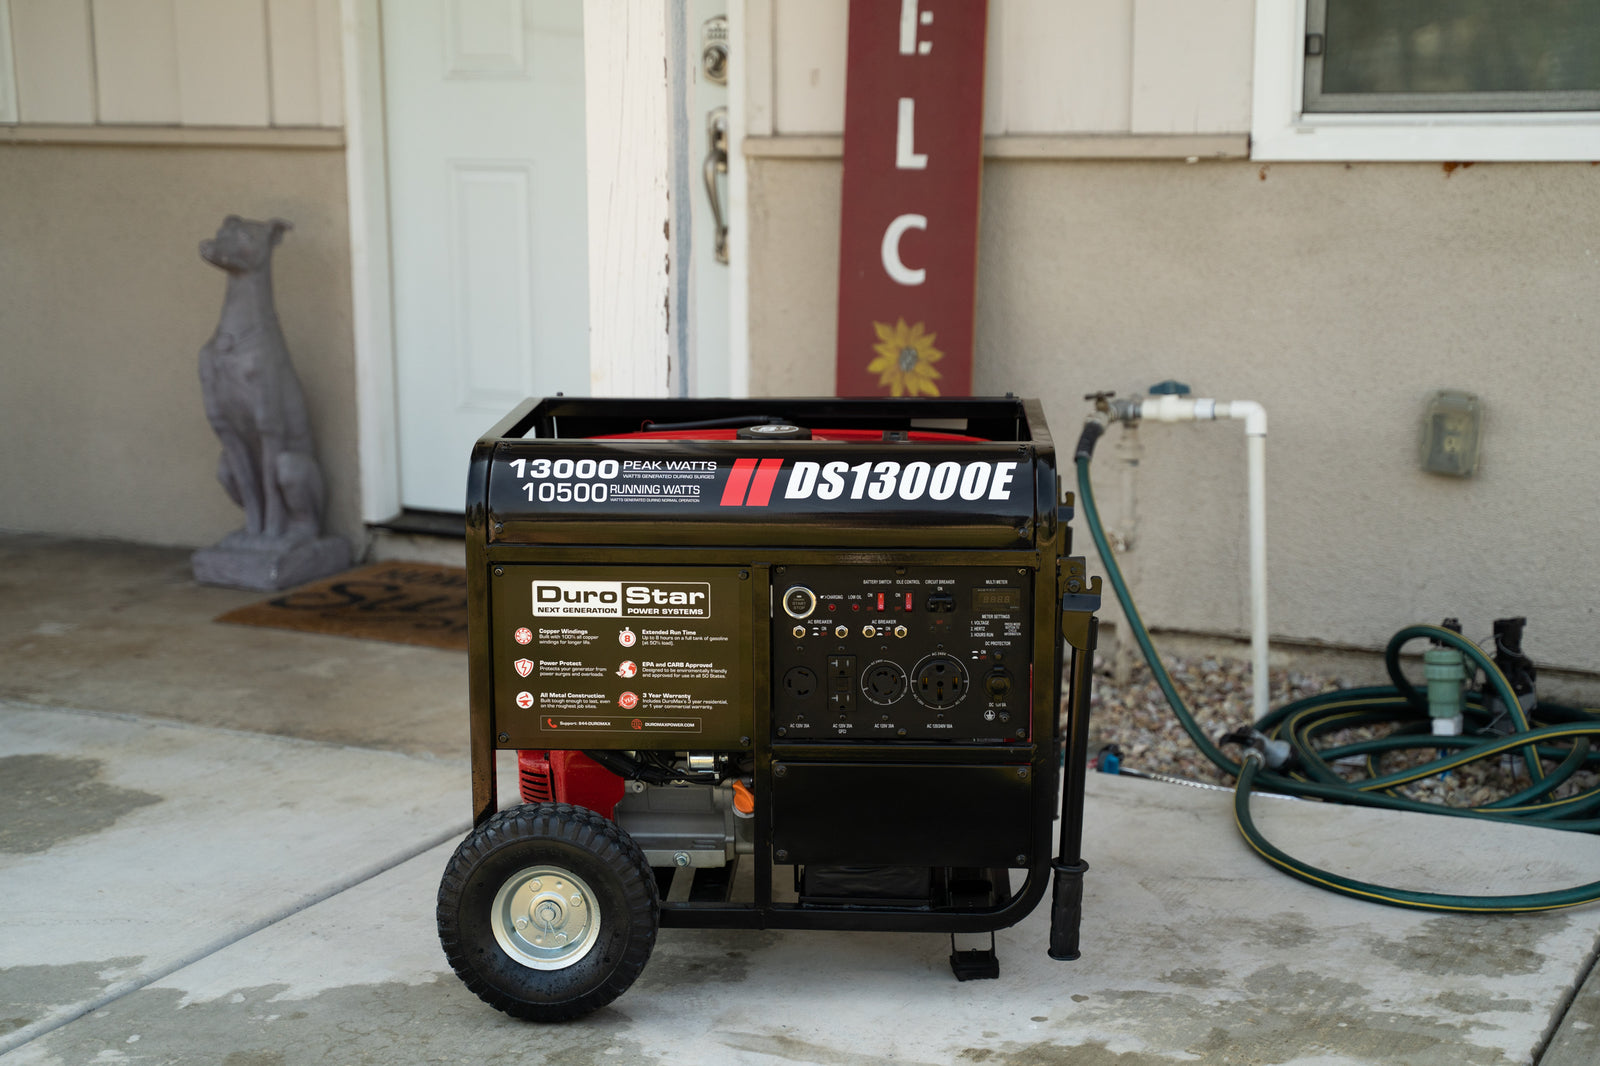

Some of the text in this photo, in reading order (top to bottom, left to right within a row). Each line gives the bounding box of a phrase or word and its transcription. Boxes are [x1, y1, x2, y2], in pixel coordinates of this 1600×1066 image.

[509, 459, 717, 478] 13000 PEAK WATTS
[784, 462, 1018, 500] DS13000E
[522, 482, 700, 502] 10500 RUNNING WATTS
[537, 586, 704, 605] Duro Star
